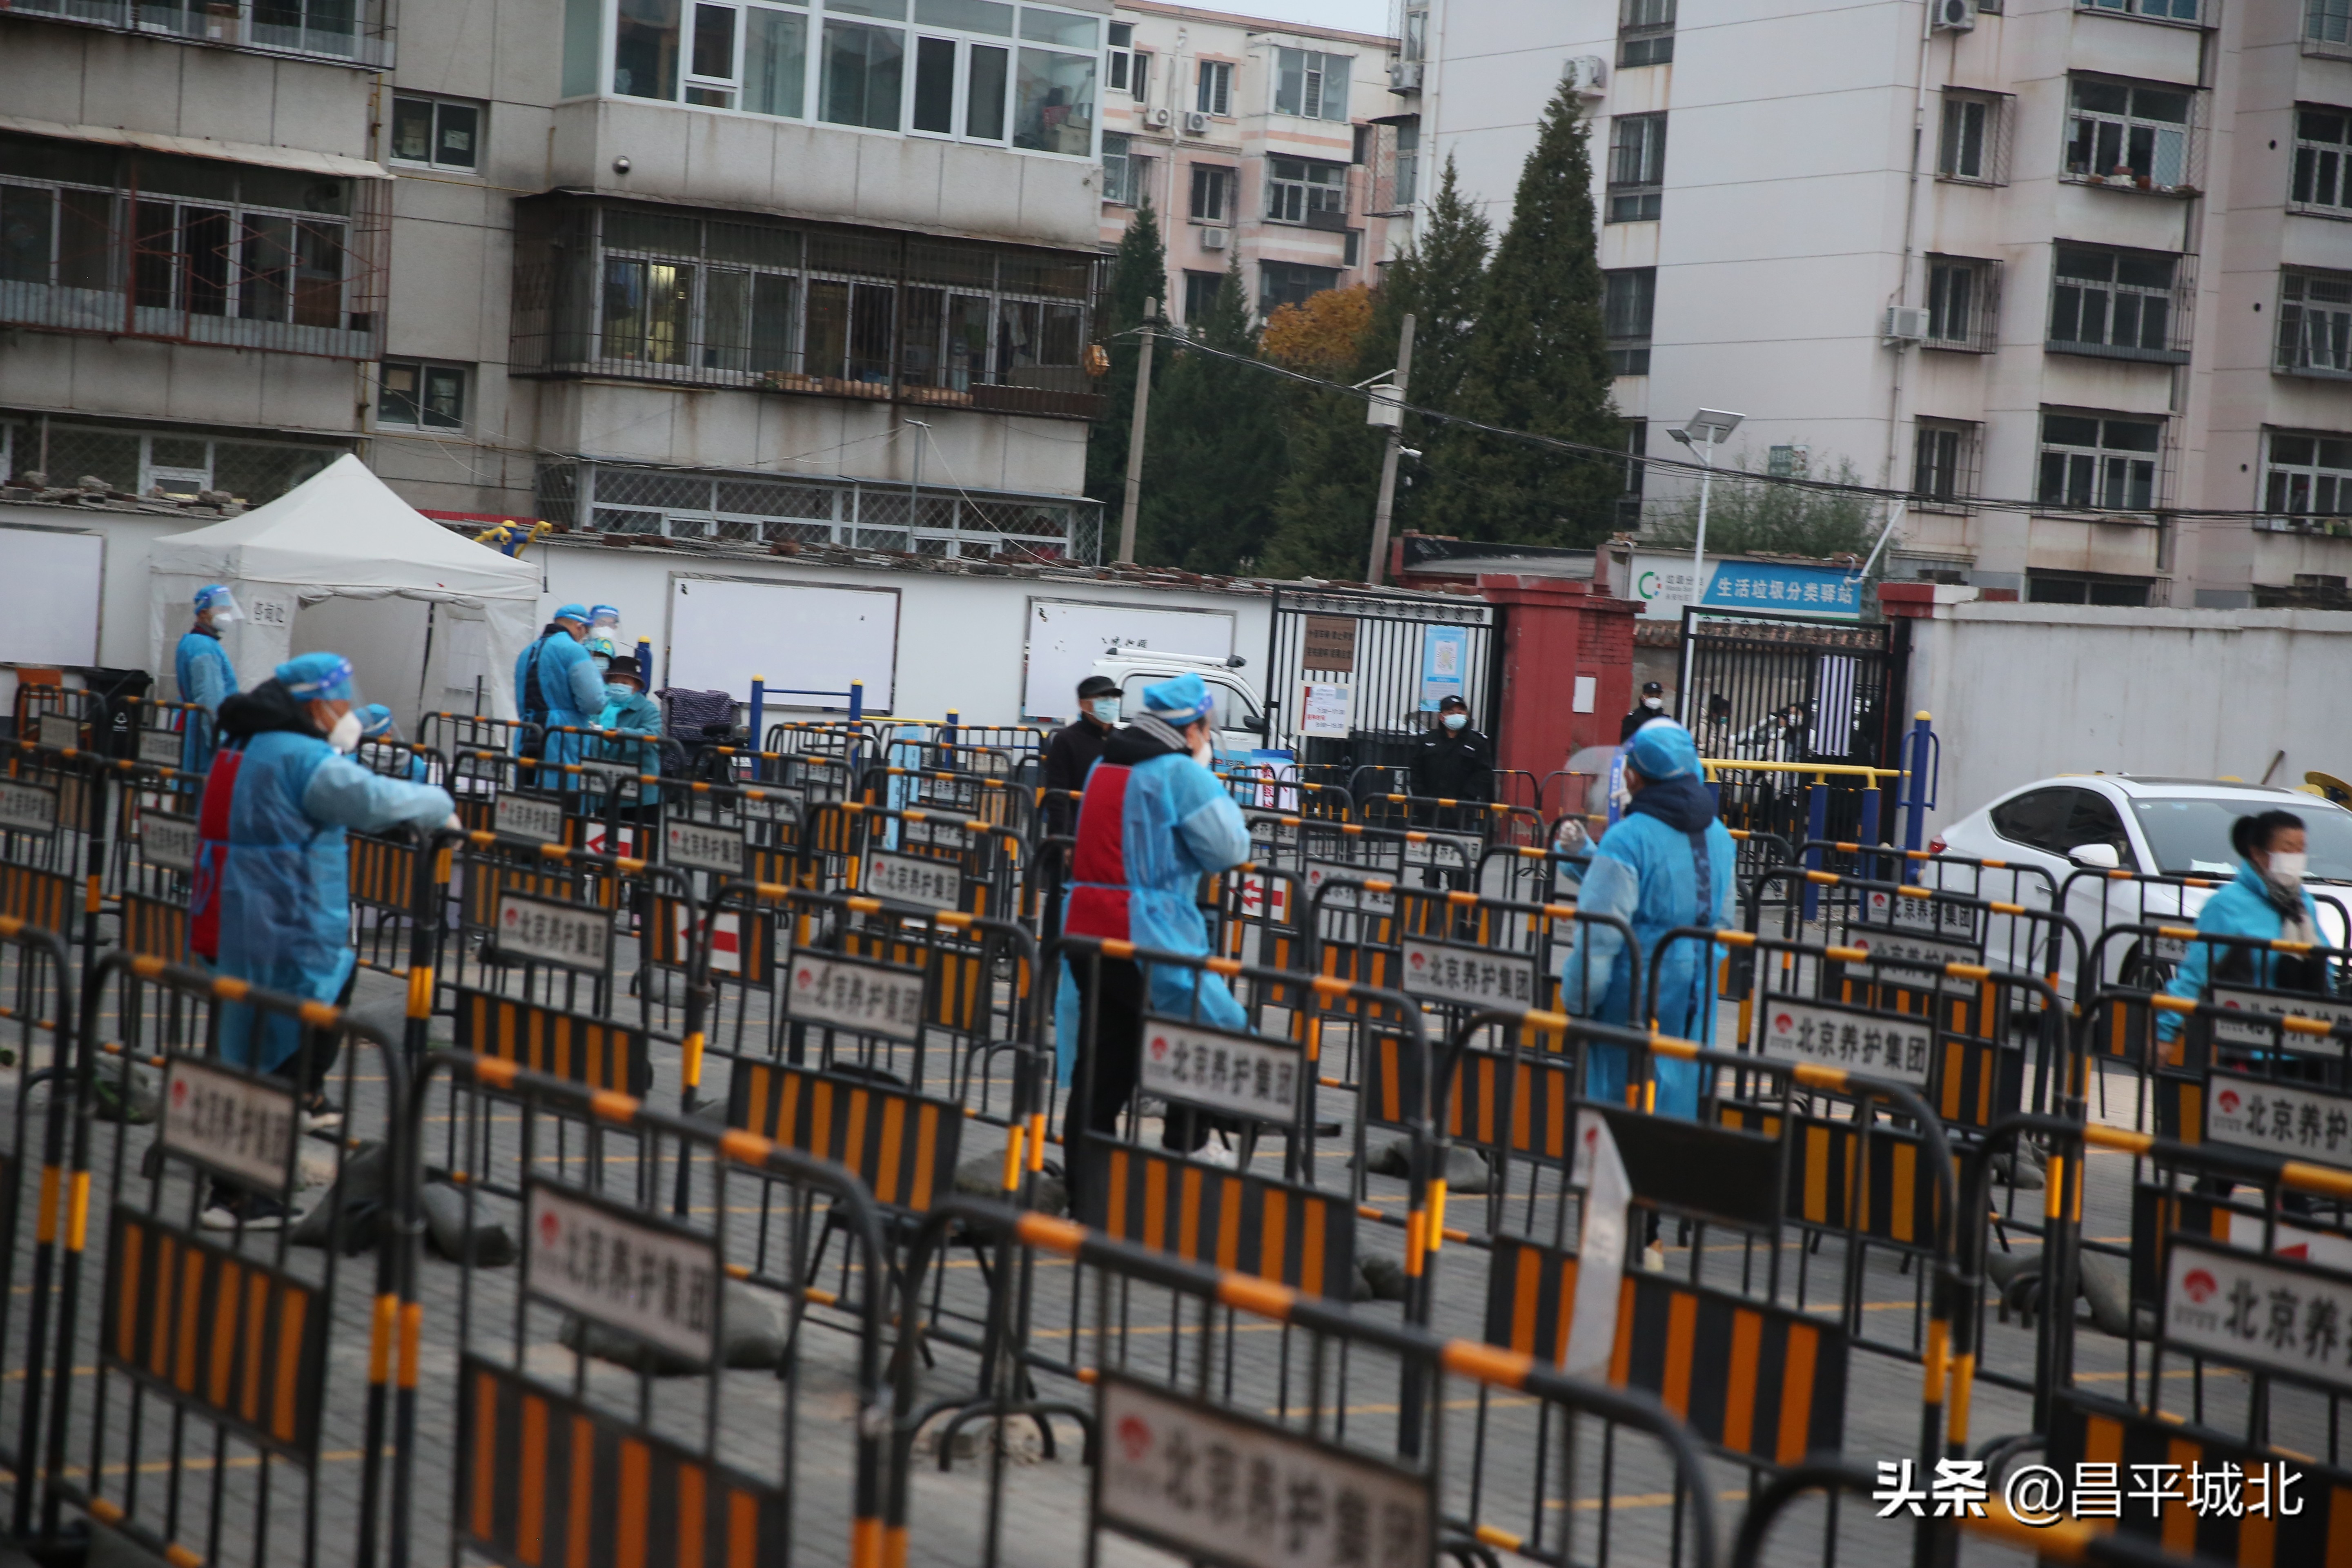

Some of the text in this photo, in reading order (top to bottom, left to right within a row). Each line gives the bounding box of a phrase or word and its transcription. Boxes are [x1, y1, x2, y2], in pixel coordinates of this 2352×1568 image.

[254, 601, 285, 623] 咨询处
[1717, 578, 1853, 605] 生活垃圾分类驿站
[1430, 955, 1530, 1000] 北京养护集团
[1172, 1040, 1293, 1105] 北京养护集团
[1799, 1017, 1925, 1073] 北京养护集团
[2247, 1094, 2352, 1151] 北京养护
[2224, 1277, 2352, 1367] 北京养
